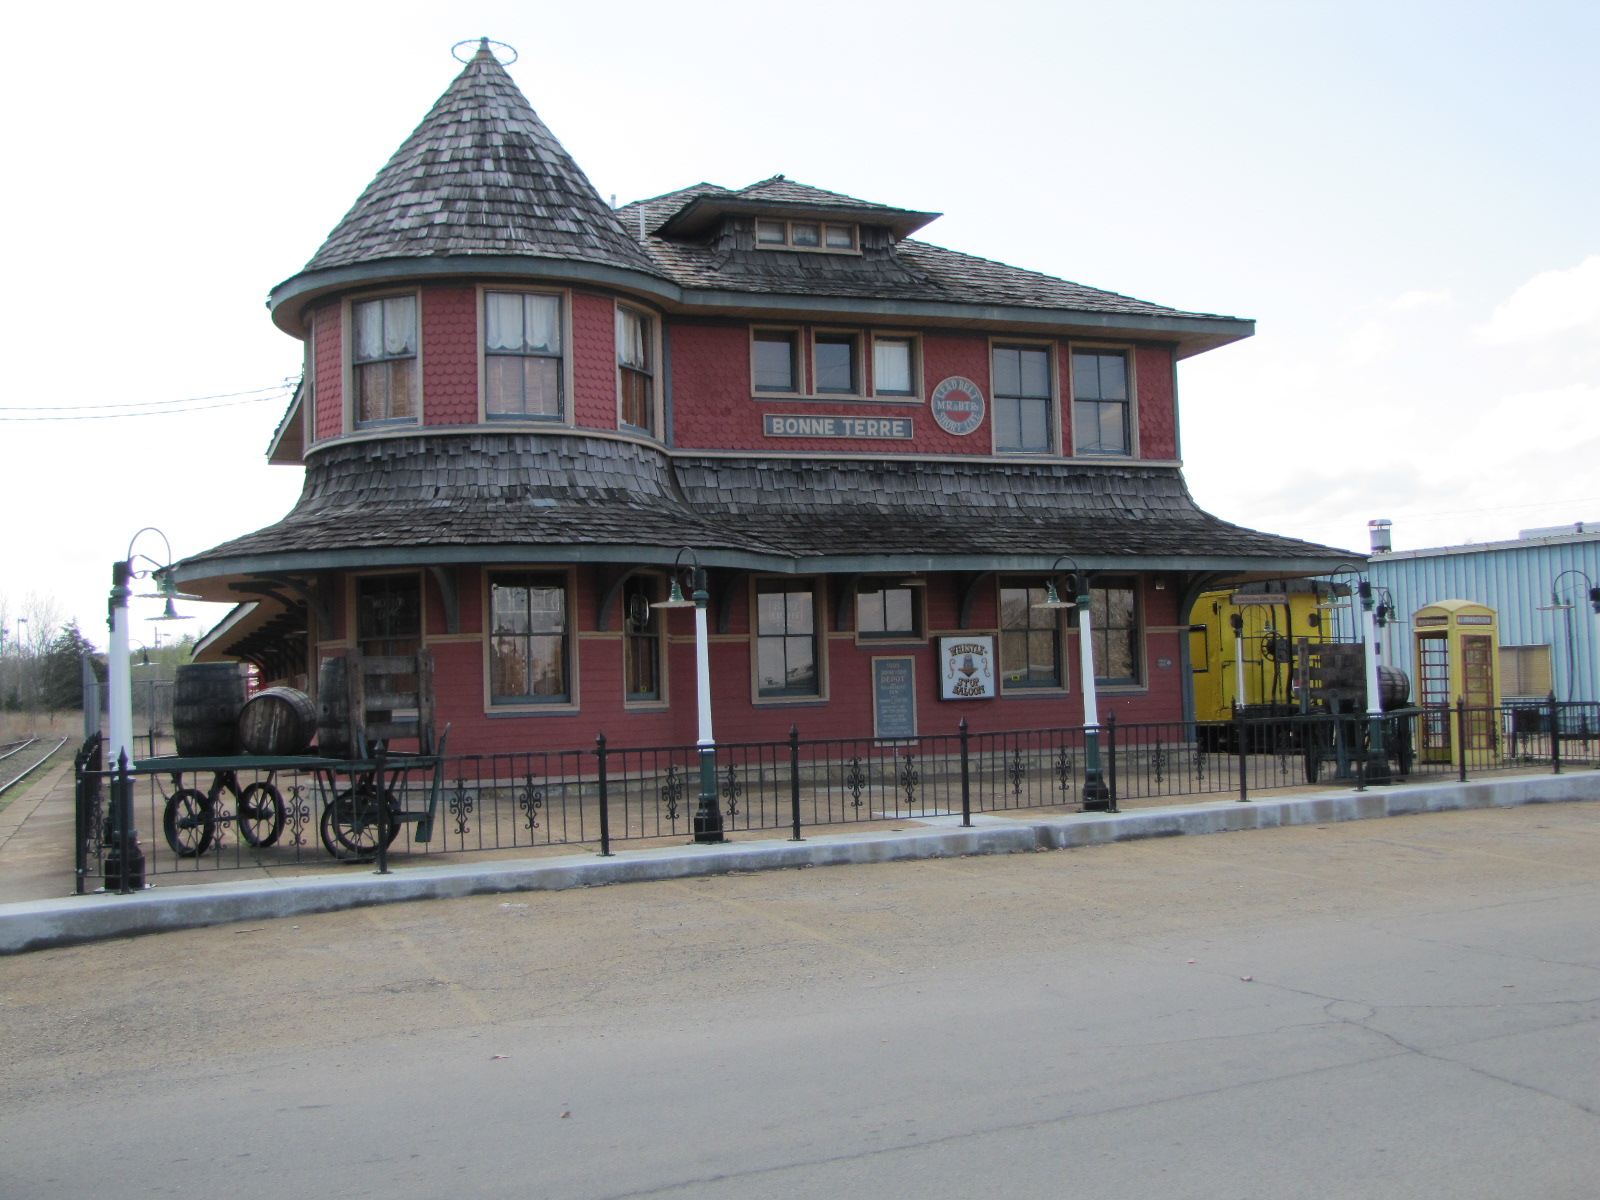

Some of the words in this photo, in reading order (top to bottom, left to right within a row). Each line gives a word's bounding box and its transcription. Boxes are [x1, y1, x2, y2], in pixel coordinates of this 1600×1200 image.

[935, 379, 957, 399] LEAD
[958, 379, 980, 399] BELT
[772, 418, 835, 435] BONNE
[843, 419, 905, 437] TERRE
[936, 411, 962, 432] SHORT
[964, 411, 982, 432] LINE
[881, 675, 906, 683] DEPOT
[957, 677, 980, 688] STOP
[952, 684, 986, 697] SALOON
